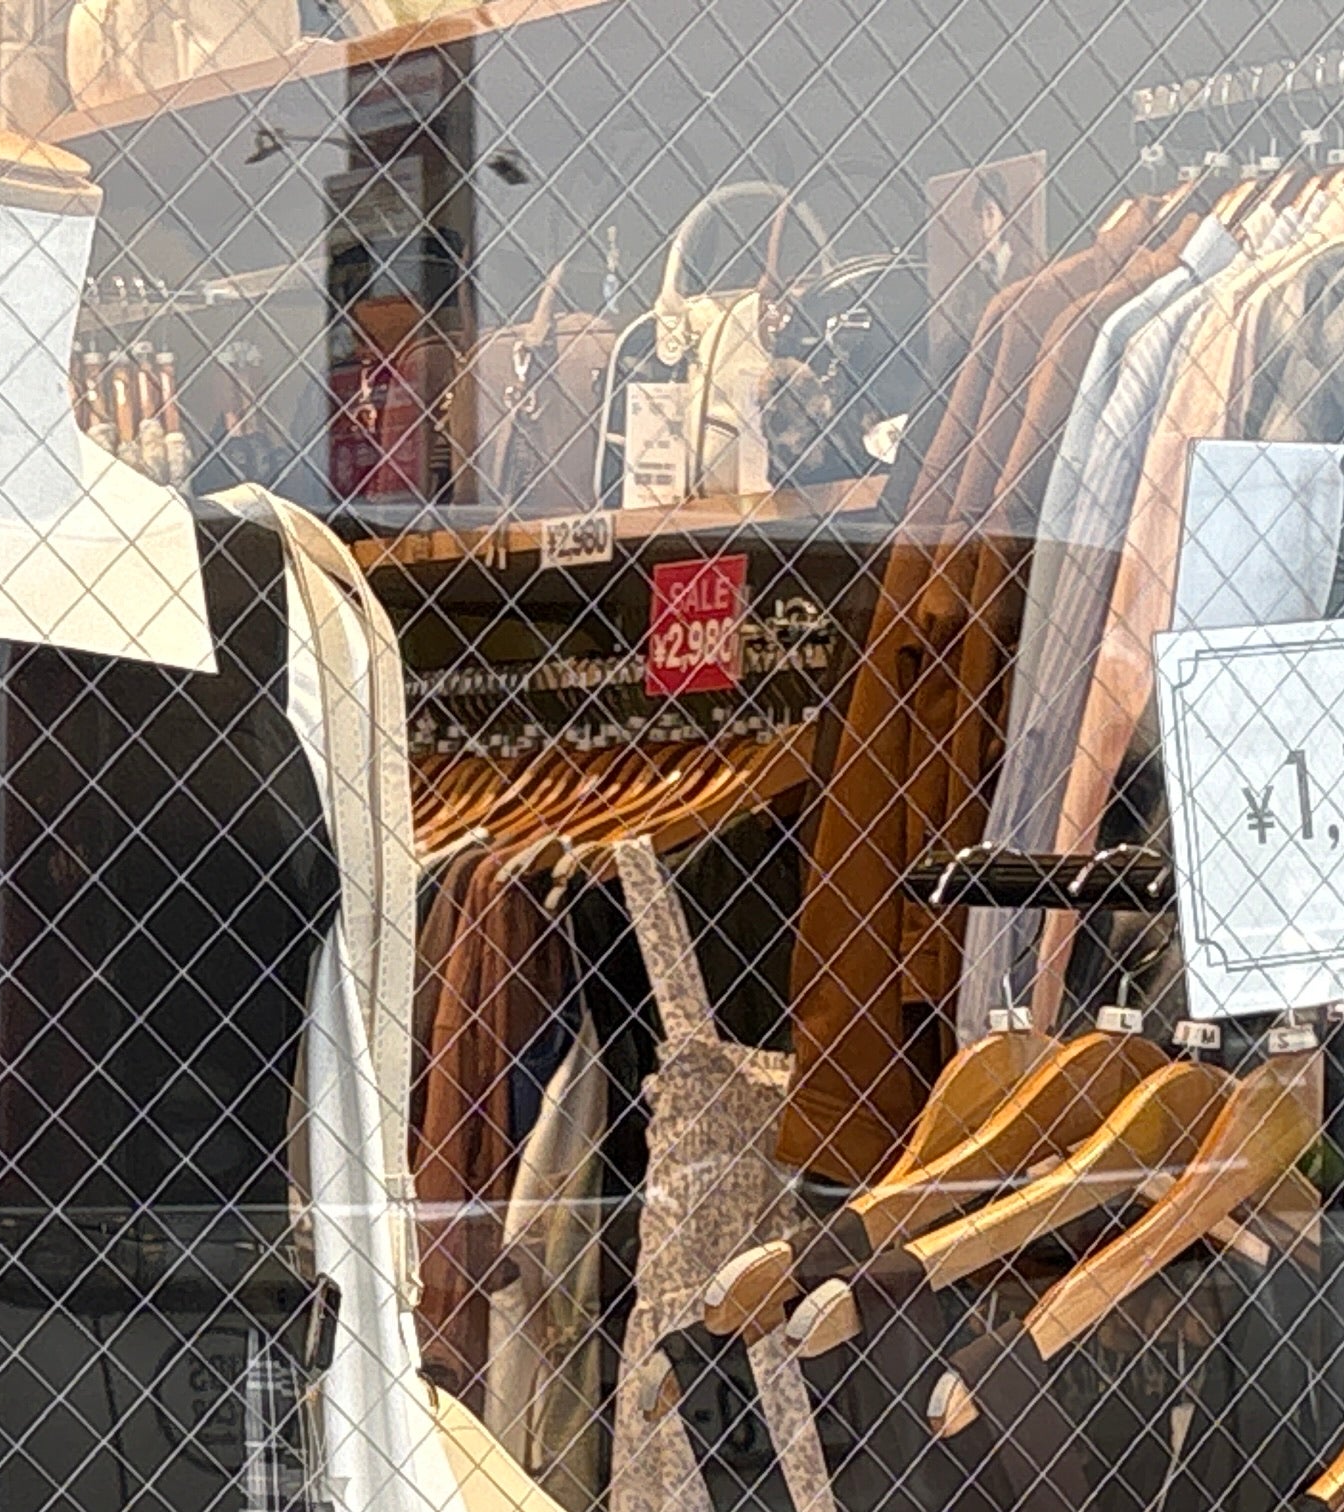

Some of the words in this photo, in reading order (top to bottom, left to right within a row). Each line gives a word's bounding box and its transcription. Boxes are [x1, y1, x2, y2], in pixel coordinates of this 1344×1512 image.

[668, 579, 730, 613] SALE
[653, 618, 735, 672] ¥2,980
[1120, 1013, 1132, 1029] L
